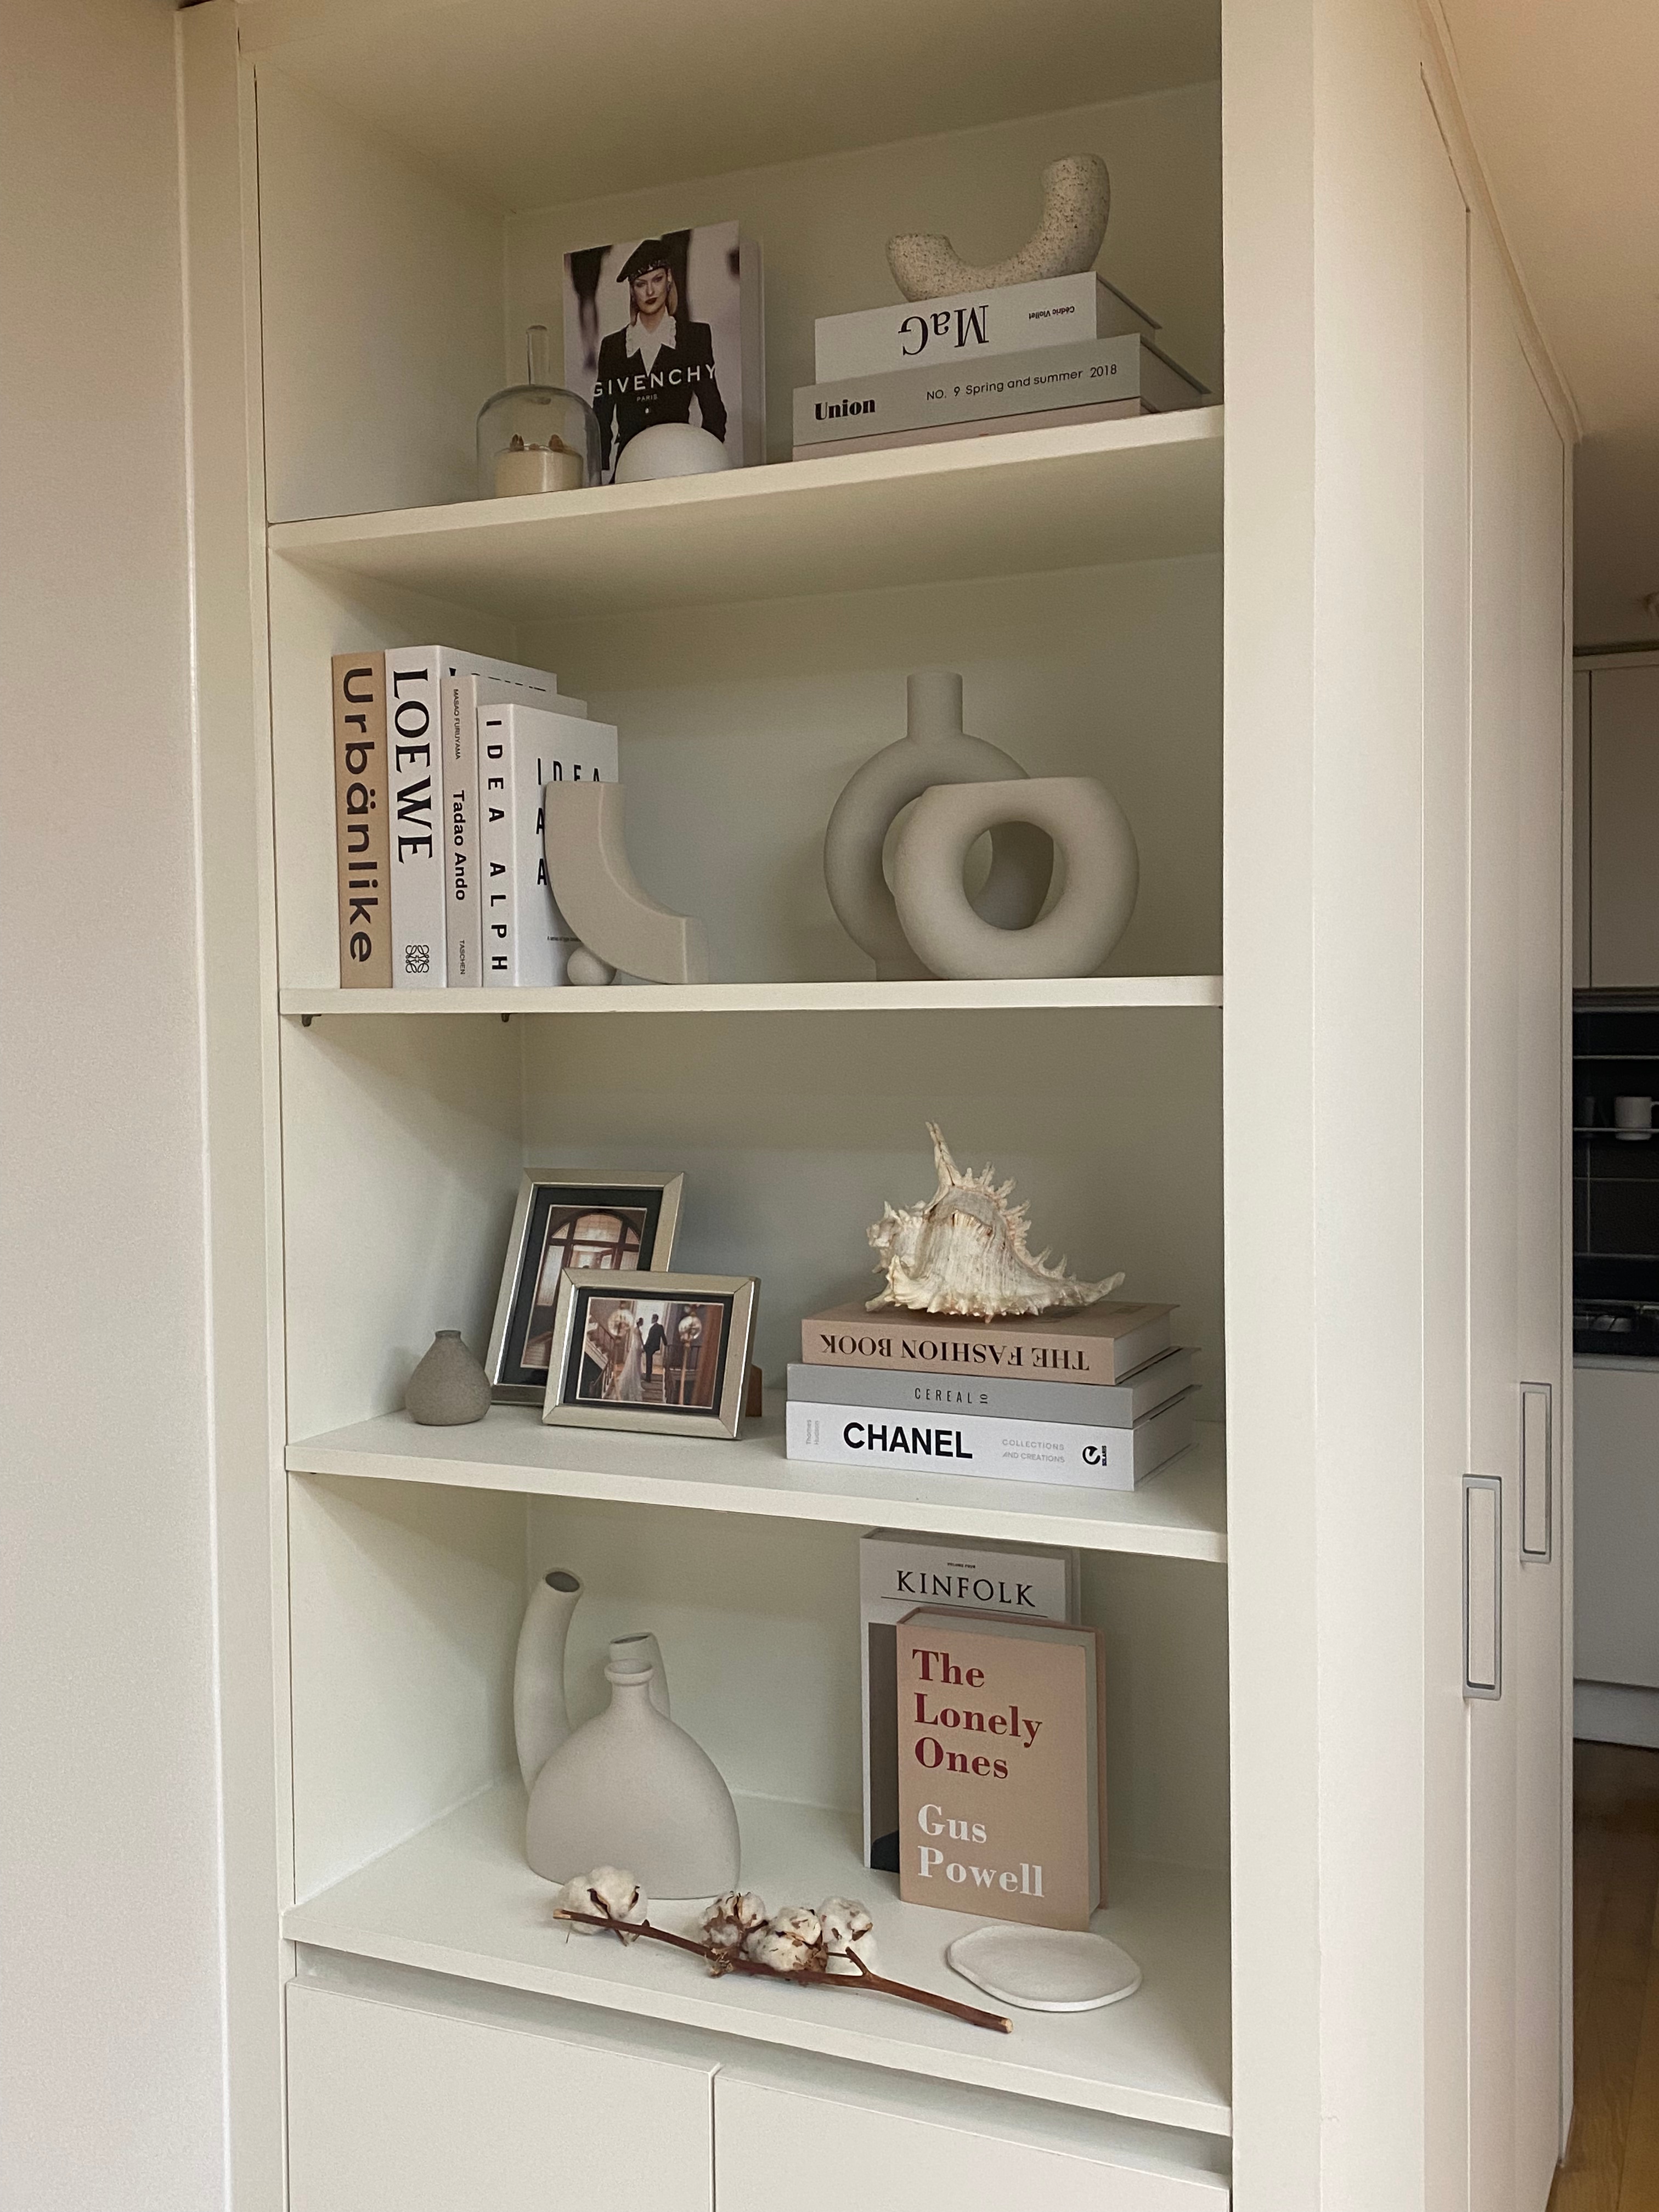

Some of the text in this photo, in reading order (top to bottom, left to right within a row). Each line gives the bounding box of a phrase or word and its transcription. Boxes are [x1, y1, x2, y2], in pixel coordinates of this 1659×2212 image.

[594, 364, 714, 397] GIVENCHY
[637, 393, 658, 402] PARIS
[927, 364, 1118, 400] NO. 9 Spring and summer 2018
[815, 399, 876, 420] Union
[393, 668, 433, 864] LOEWE
[342, 667, 379, 962] Urbänlike
[453, 790, 467, 900] Tadao Ando
[486, 720, 508, 970] IDEA ALPH
[820, 1334, 1090, 1370] THE FASHION BOOK
[915, 1388, 972, 1403] CEREAL
[843, 1421, 973, 1459] CHANEL
[1002, 1439, 1064, 1451] COLLECTIONS
[1021, 1453, 1065, 1463] CREATIONS
[897, 1570, 1036, 1607] KINFOLK
[912, 1649, 985, 1688] The
[913, 1692, 1043, 1748] Lonely
[915, 1737, 1009, 1779] Ones
[917, 1804, 988, 1843] Gus
[917, 1846, 1045, 1898] Powell
